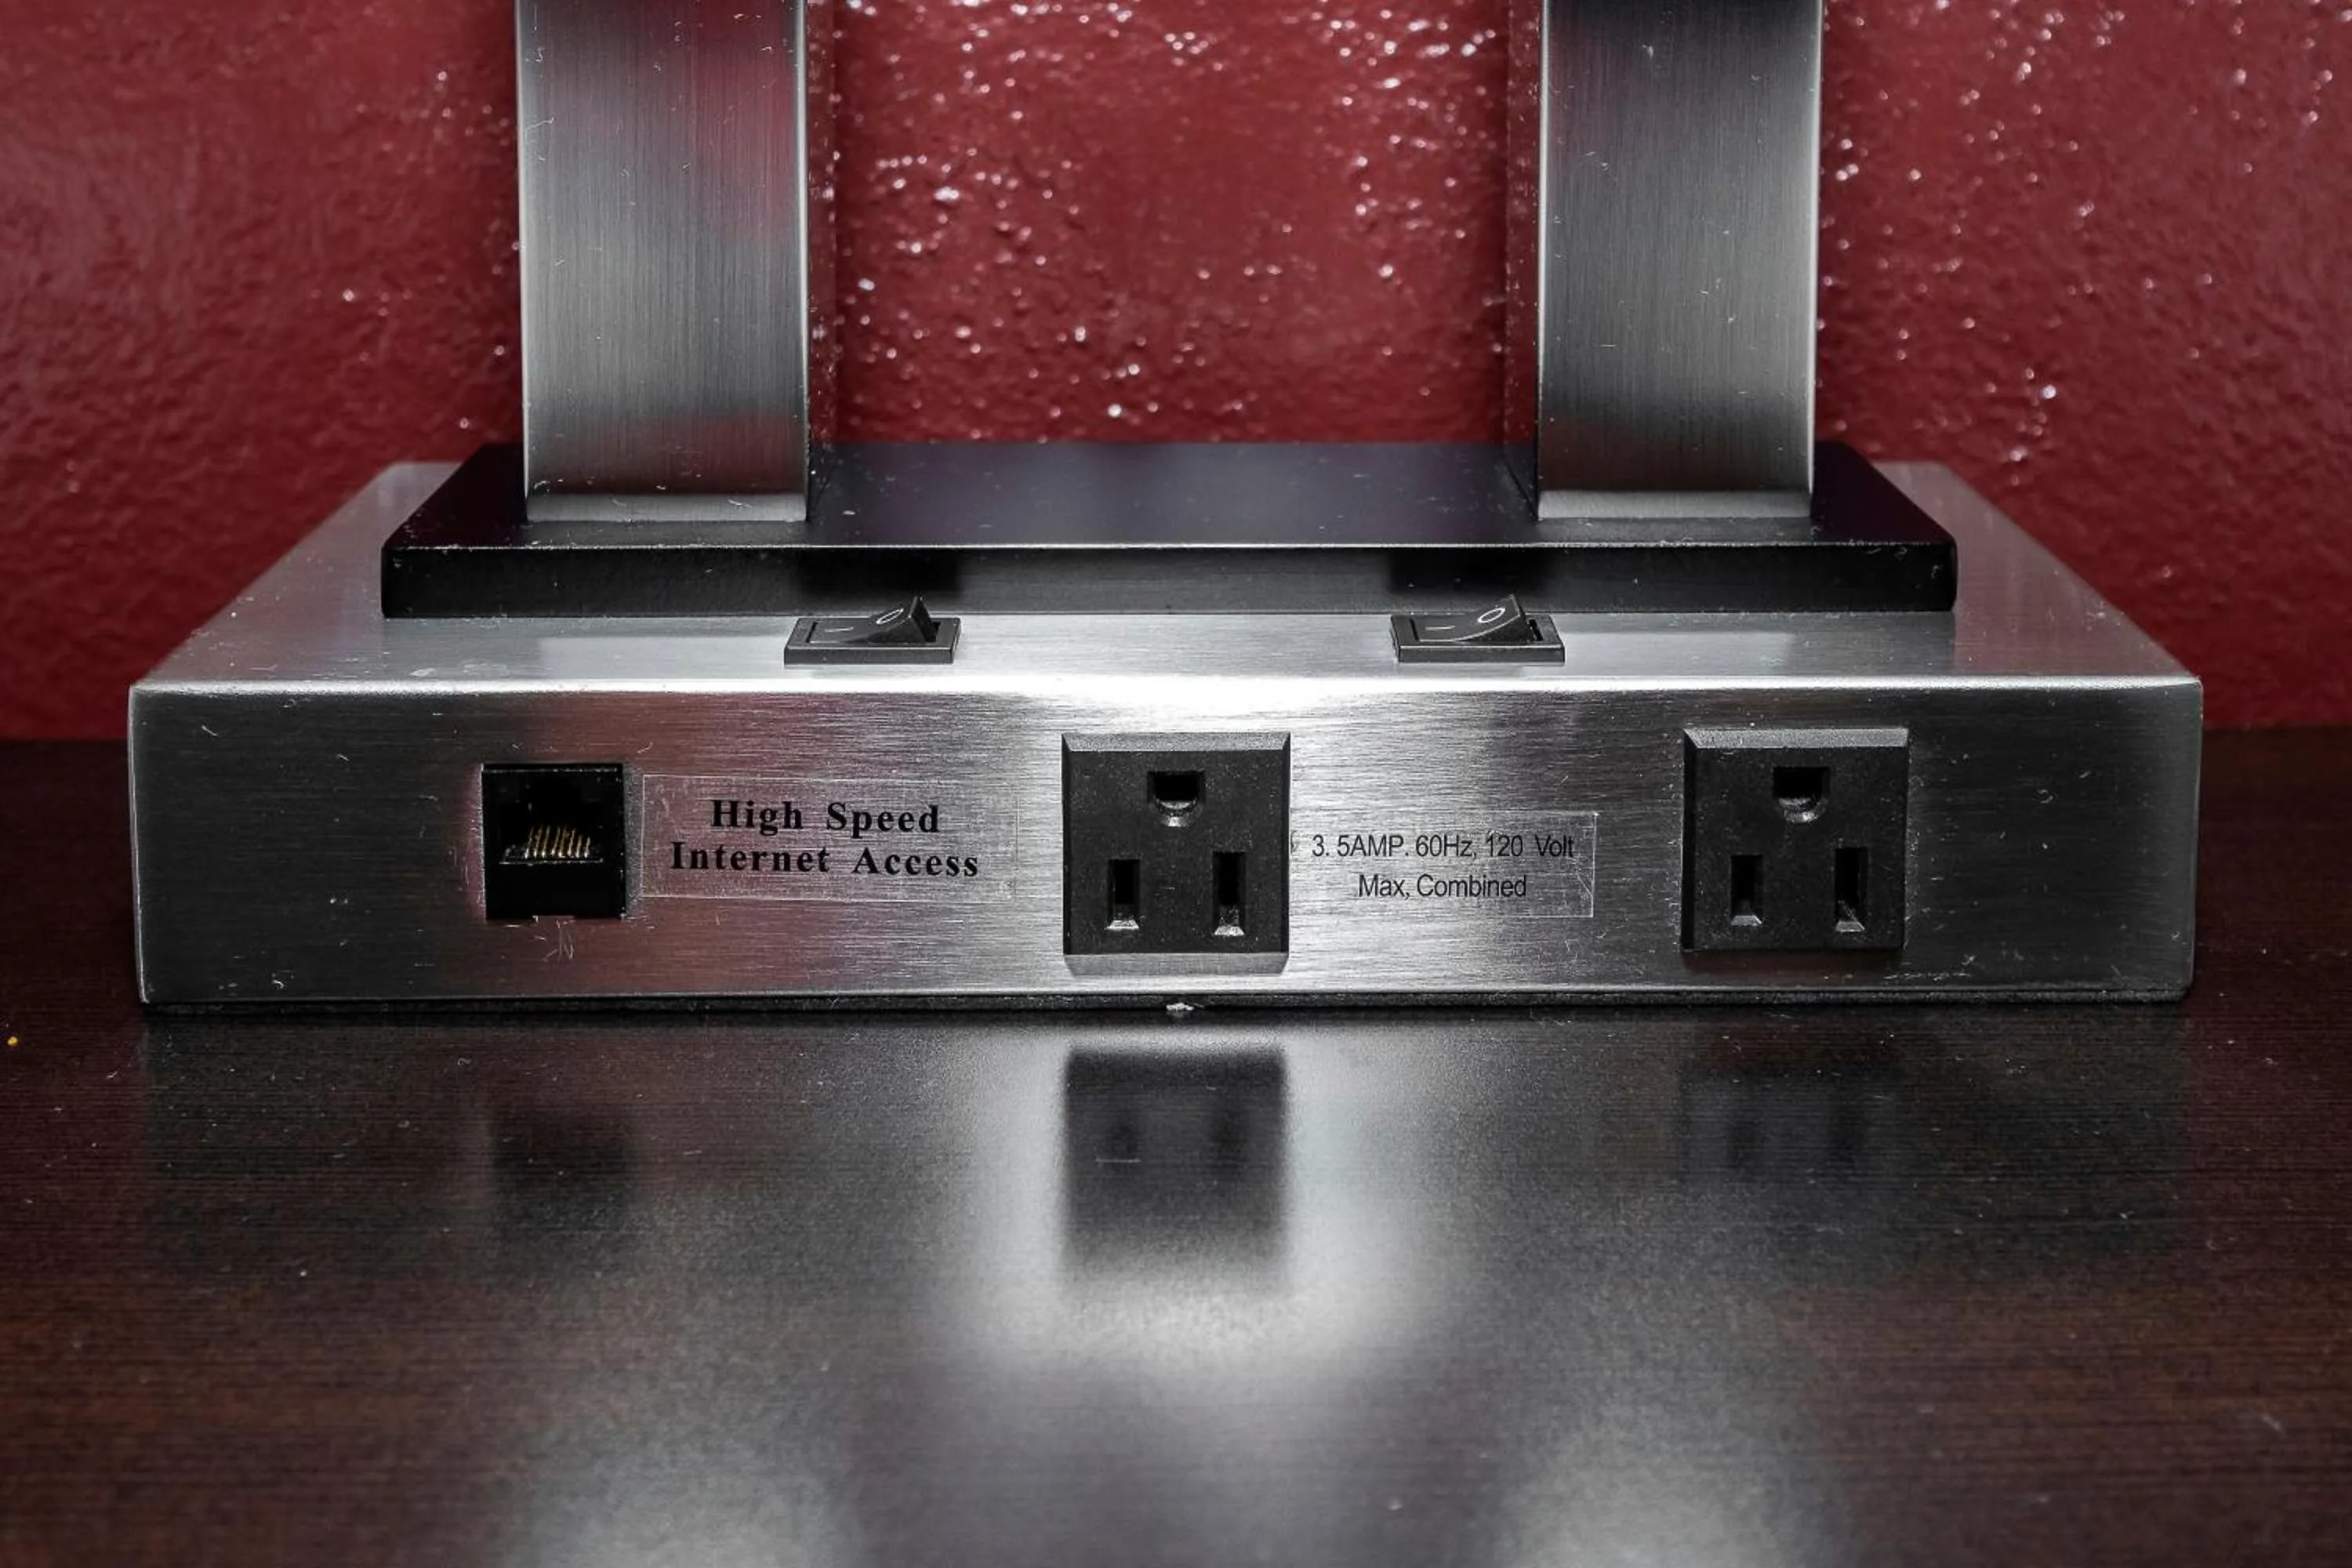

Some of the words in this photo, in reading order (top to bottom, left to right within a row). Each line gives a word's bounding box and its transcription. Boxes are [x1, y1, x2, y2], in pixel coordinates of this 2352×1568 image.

[710, 799, 803, 835] High
[826, 802, 940, 838] Speed
[670, 841, 830, 872] Internet
[852, 848, 978, 877] Access
[1415, 835, 1477, 858] 60Hz,
[1486, 835, 1523, 857] 120
[1534, 834, 1574, 858] Volt
[1358, 875, 1410, 900] Max,
[1417, 873, 1527, 898] Combined
